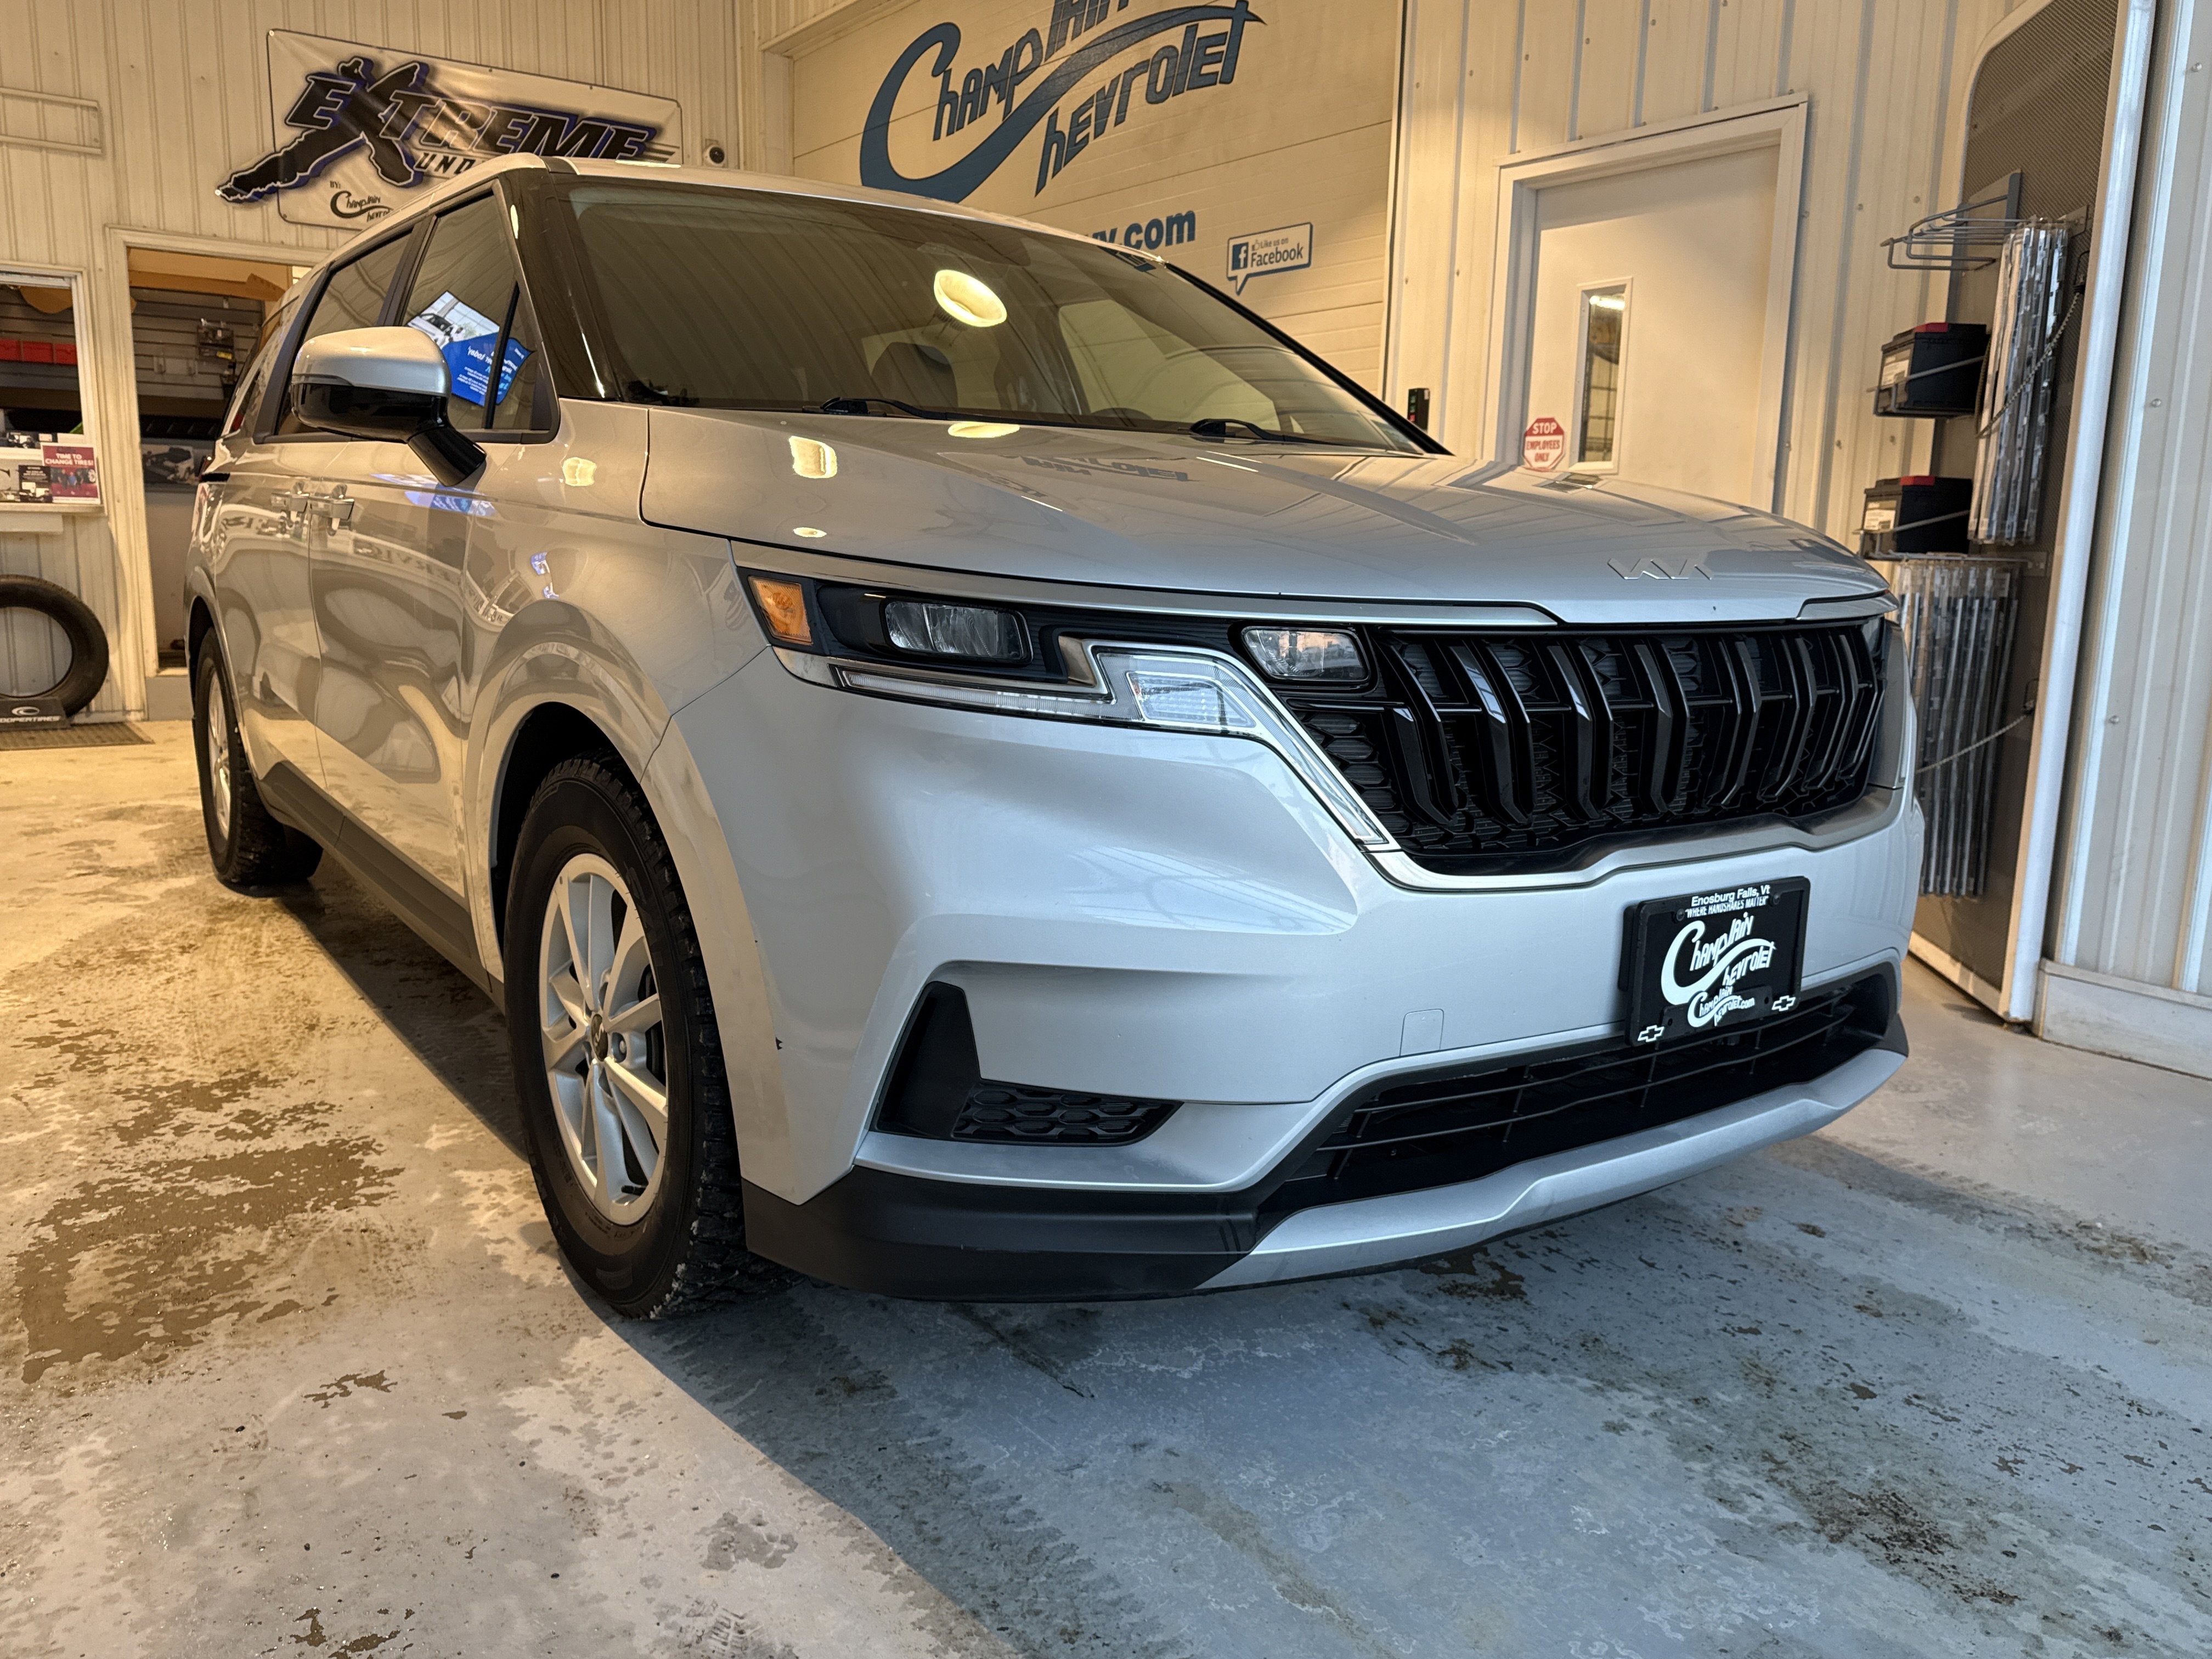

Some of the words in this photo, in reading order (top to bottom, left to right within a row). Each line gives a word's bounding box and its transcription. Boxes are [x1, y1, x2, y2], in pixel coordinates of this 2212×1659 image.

[216, 57, 658, 204] EXTREME
[1261, 240, 1272, 249] Like
[1251, 242, 1304, 268] Facebook
[1532, 422, 1557, 434] STOP
[1526, 440, 1560, 450] EMPLOYEES
[1534, 453, 1550, 462] ONLY
[1691, 892, 1735, 907] Enosburg
[1737, 887, 1759, 899] Falls,
[1760, 884, 1770, 895] Vt
[1708, 899, 1745, 915] HANDSHAKES
